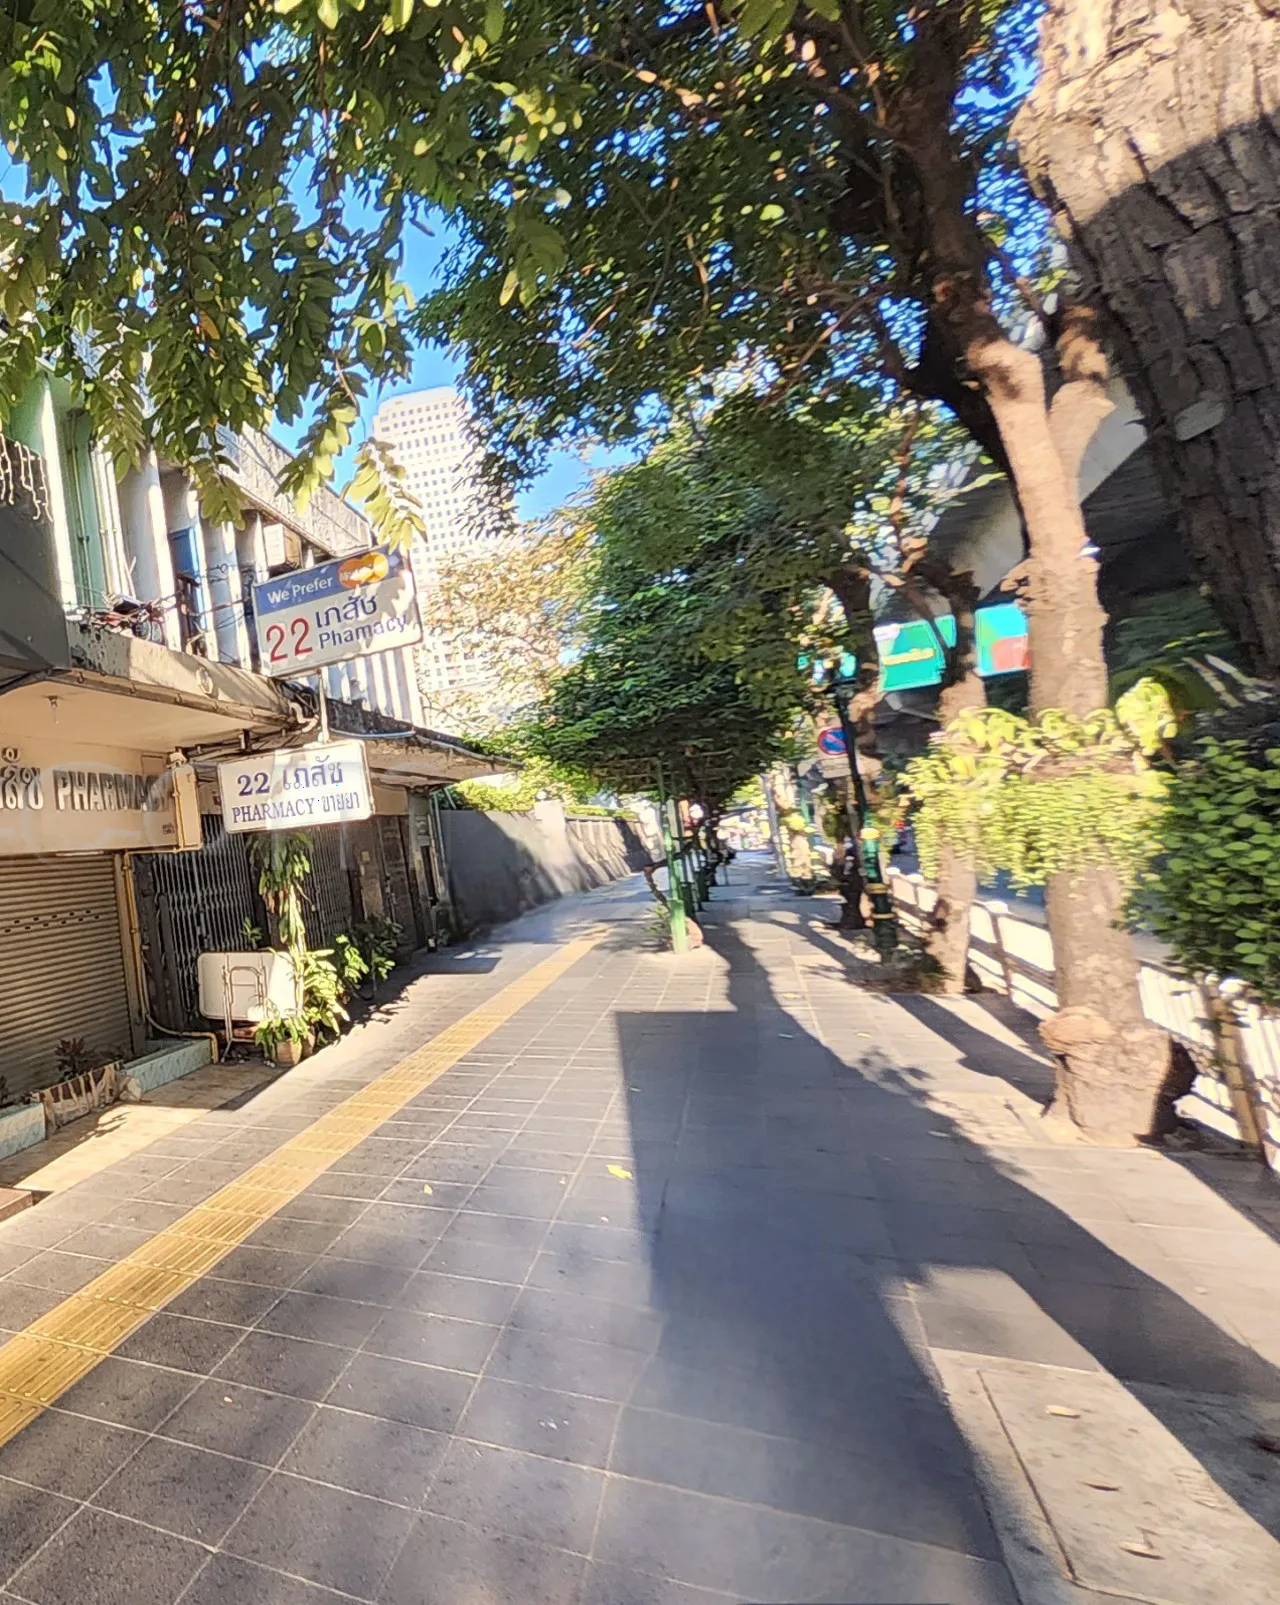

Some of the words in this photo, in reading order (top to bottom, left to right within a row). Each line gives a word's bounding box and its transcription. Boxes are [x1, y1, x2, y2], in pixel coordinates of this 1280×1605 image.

[267, 590, 291, 605] We
[292, 577, 334, 598] Prefer
[265, 617, 313, 663] 22
[315, 594, 378, 629] เภสัช
[319, 613, 408, 650] Phamacy
[236, 771, 271, 797] 22
[282, 755, 344, 791] เภสัช
[232, 797, 315, 823] PHARMACY
[321, 791, 360, 813] ขายยา
